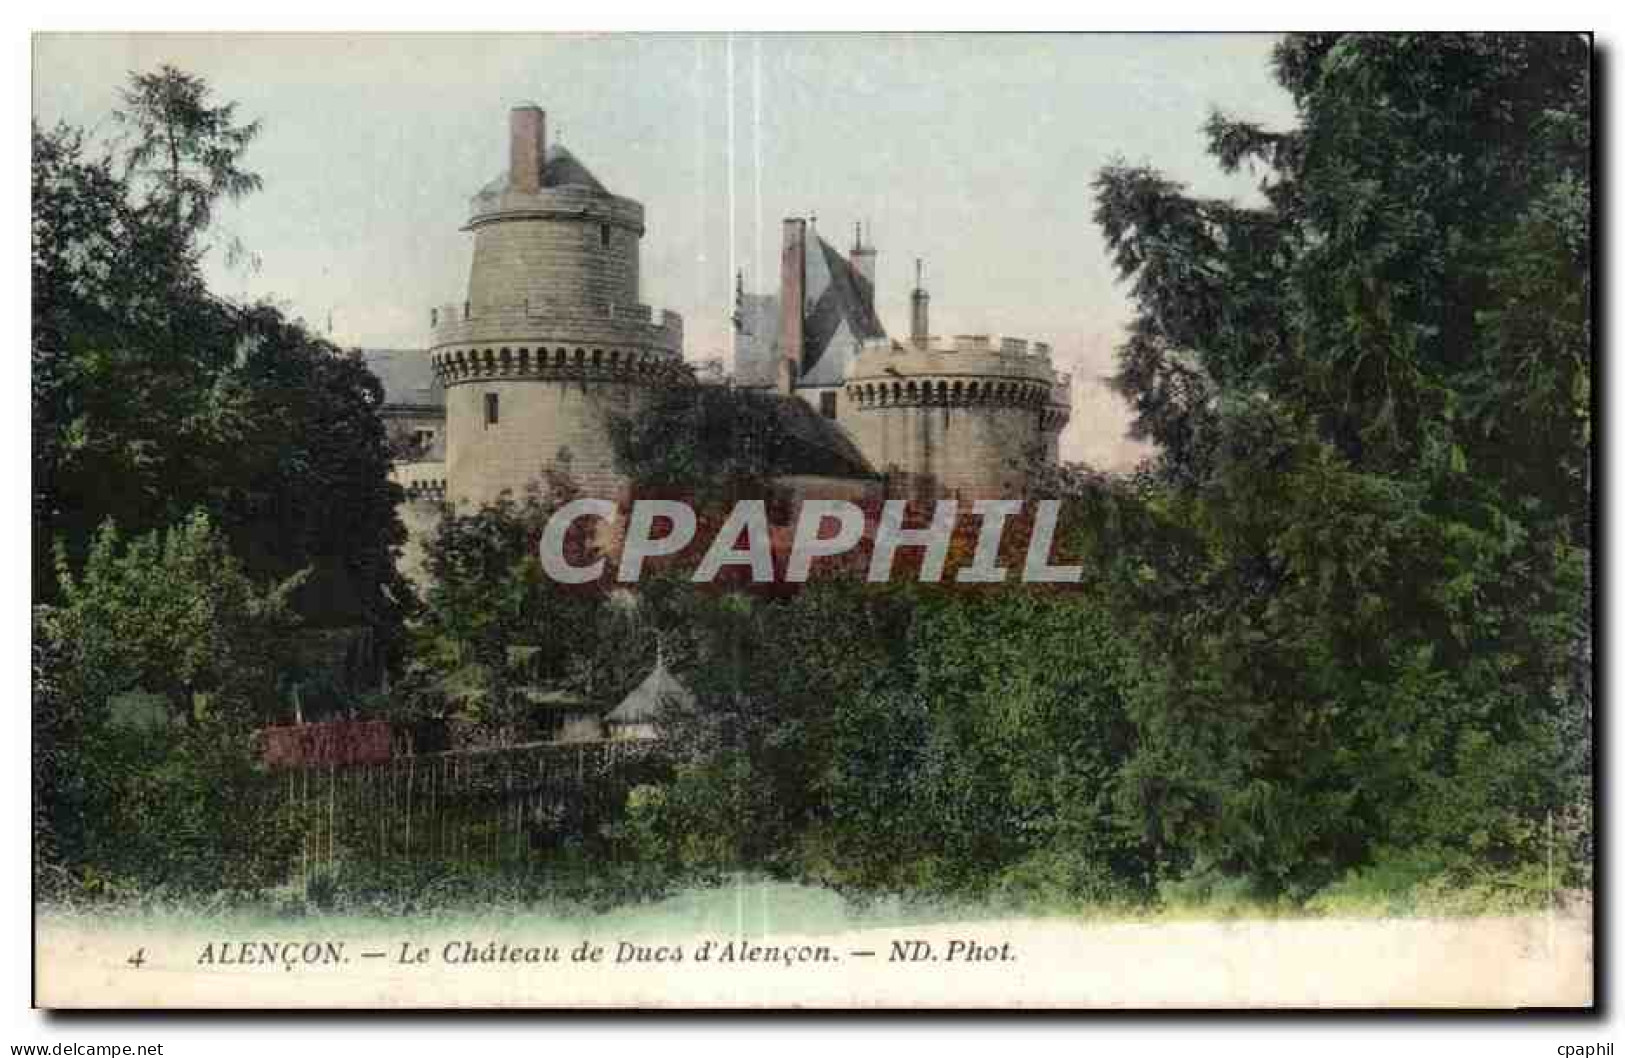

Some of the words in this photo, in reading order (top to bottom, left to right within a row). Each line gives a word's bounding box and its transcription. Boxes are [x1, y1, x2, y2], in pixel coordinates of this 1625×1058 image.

[127, 948, 146, 968] 4
[197, 942, 350, 971] ALENÇON.
[399, 942, 431, 964] Le
[570, 941, 604, 962] de
[615, 941, 685, 963] Ducs
[888, 940, 938, 961] ND.
[945, 940, 1017, 961] Phot.
